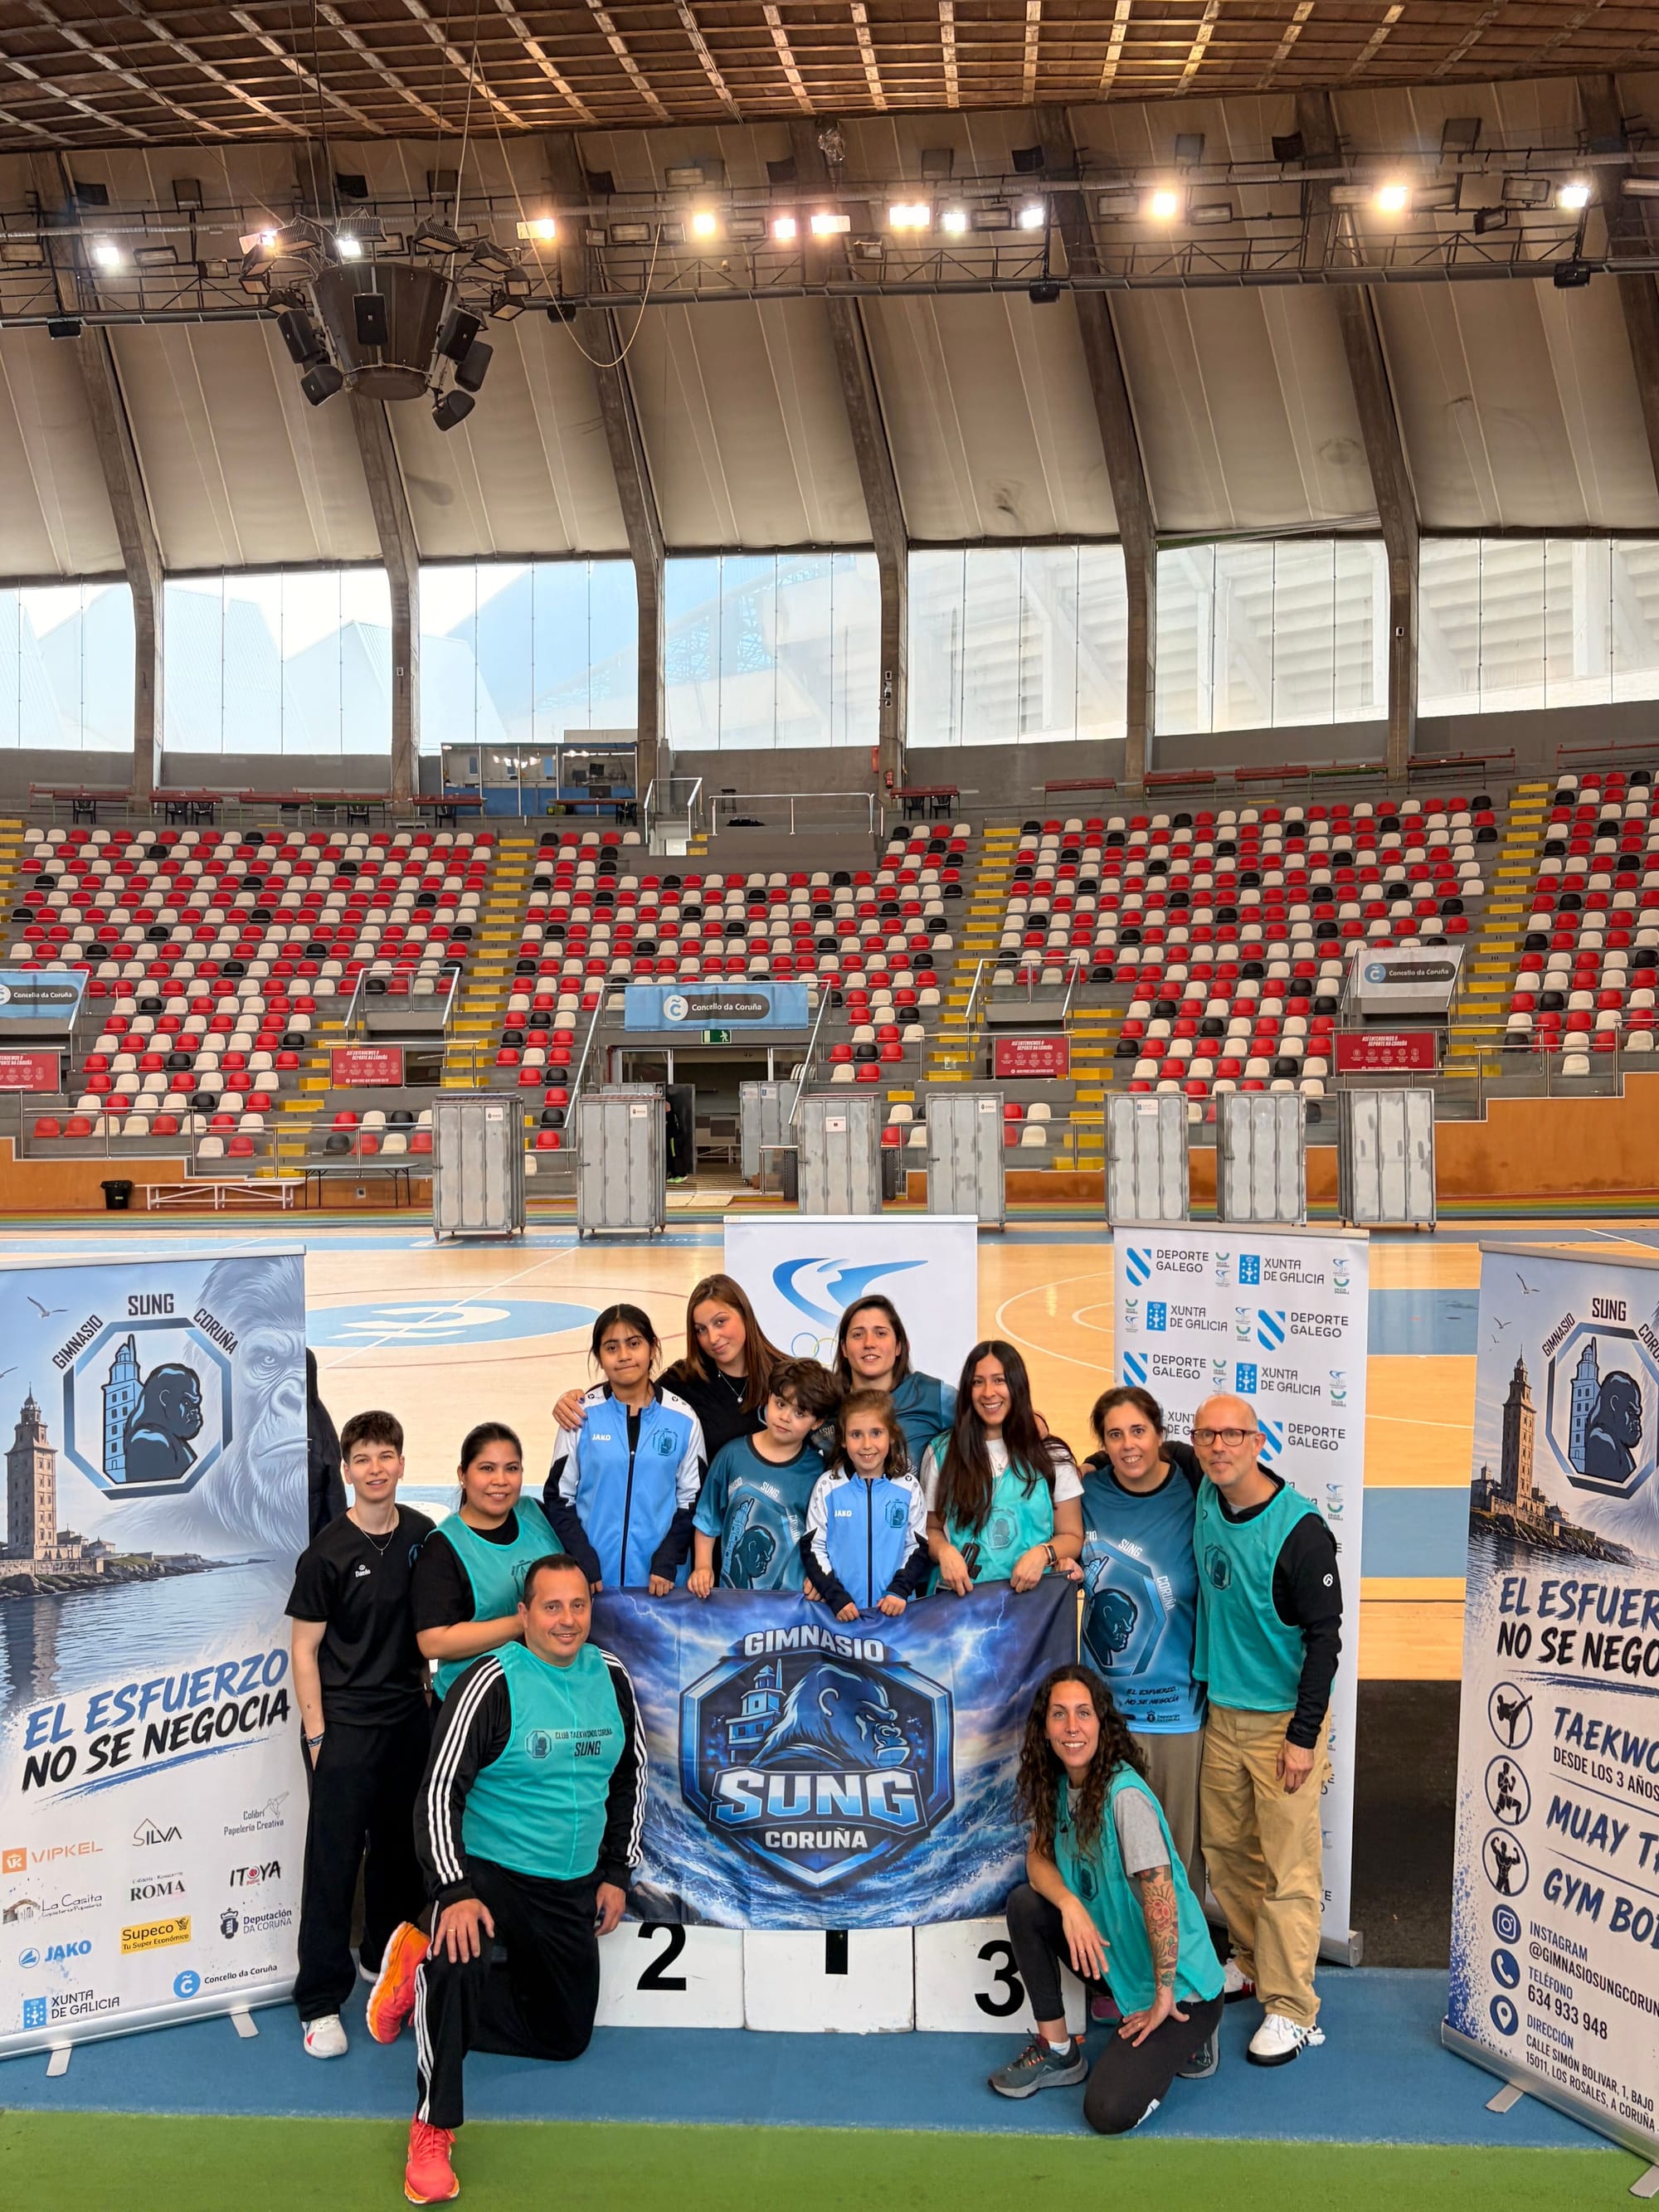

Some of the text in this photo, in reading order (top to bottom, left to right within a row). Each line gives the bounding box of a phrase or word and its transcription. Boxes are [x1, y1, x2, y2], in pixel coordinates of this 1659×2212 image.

[692, 1003, 722, 1011] Concello
[735, 1002, 762, 1011] Coruña
[1156, 1249, 1209, 1262] DEPORTE
[1263, 1258, 1301, 1270] XUNTA
[1155, 1261, 1203, 1273] GALEGO
[1263, 1271, 1277, 1281] DE
[1280, 1272, 1325, 1285] GALICIA
[1170, 1305, 1206, 1317] XUNTA
[1290, 1312, 1349, 1326] DEPORTE
[52, 1293, 239, 1369] GIMNASIO SUNG CORUÑA
[1170, 1318, 1228, 1332] DE GALICIA
[1290, 1326, 1341, 1339] GALEGO
[1542, 1312, 1575, 1357] GIMNASIO
[1593, 1298, 1627, 1321] SUNG
[1152, 1354, 1207, 1369] DEPORTE
[1152, 1367, 1200, 1379] GALEGO
[1261, 1368, 1298, 1380] XUNTA
[1261, 1380, 1321, 1396] DE GALICIA
[592, 1433, 611, 1441] JAKO
[1167, 1424, 1180, 1435] DE
[1288, 1423, 1345, 1439] DEPORTE
[1287, 1437, 1339, 1451] GALEGO
[760, 1481, 780, 1499] SUNG
[1118, 1539, 1143, 1558] SUNG
[1499, 1577, 1531, 1616] EL
[743, 1625, 884, 1662] GIMNASIO
[1497, 1621, 1532, 1659] NO
[1535, 1626, 1577, 1665] SE
[23, 1649, 289, 1751] EL ESFUERZO
[22, 1688, 291, 1794] NO SE NEGOCIA
[574, 1740, 601, 1757] SUNG
[1554, 1746, 1588, 1775] DESDE
[1592, 1761, 1613, 1784] LOS
[1617, 1771, 1624, 1787] 3
[715, 1768, 921, 1826] SUNG
[133, 1818, 182, 1846] SILVA
[224, 1819, 285, 1835] Papelería Creativa
[1545, 1795, 1630, 1857] MUAY
[765, 1827, 868, 1850] CORUÑA
[31, 1840, 103, 1864] VIPKEL
[130, 1879, 185, 1902] ROMA
[1543, 1868, 1605, 1924] GYM
[42, 1899, 59, 1912] La
[243, 1909, 292, 1925] Deputación
[243, 1918, 292, 1934] DA CORUÑA
[122, 1923, 173, 1942] Supeco
[133, 1939, 152, 1949] Super
[153, 1933, 189, 1945] Económico
[1530, 1921, 1588, 1962] INSTAGRAM
[45, 1940, 92, 1962] JAKO
[636, 1922, 688, 1991] 2
[204, 1971, 237, 1984] Concello
[238, 1969, 249, 1978] da
[250, 1964, 278, 1976] Coruña
[975, 1940, 1027, 2017] 3
[1528, 1966, 1573, 2001] TELÉFONO
[51, 1989, 94, 2007] XUNTA
[51, 1996, 119, 2020] DE GALICIA
[1528, 1984, 1608, 2040] 634 933 948
[1526, 2014, 1574, 2050] DIRECCIÓN
[1526, 2034, 1654, 2112] CALLE SIMÓN BOLIVAR, 1, BAJO
[1526, 2051, 1655, 2133] 15011, LOS ROSALES, A CORUÑA
